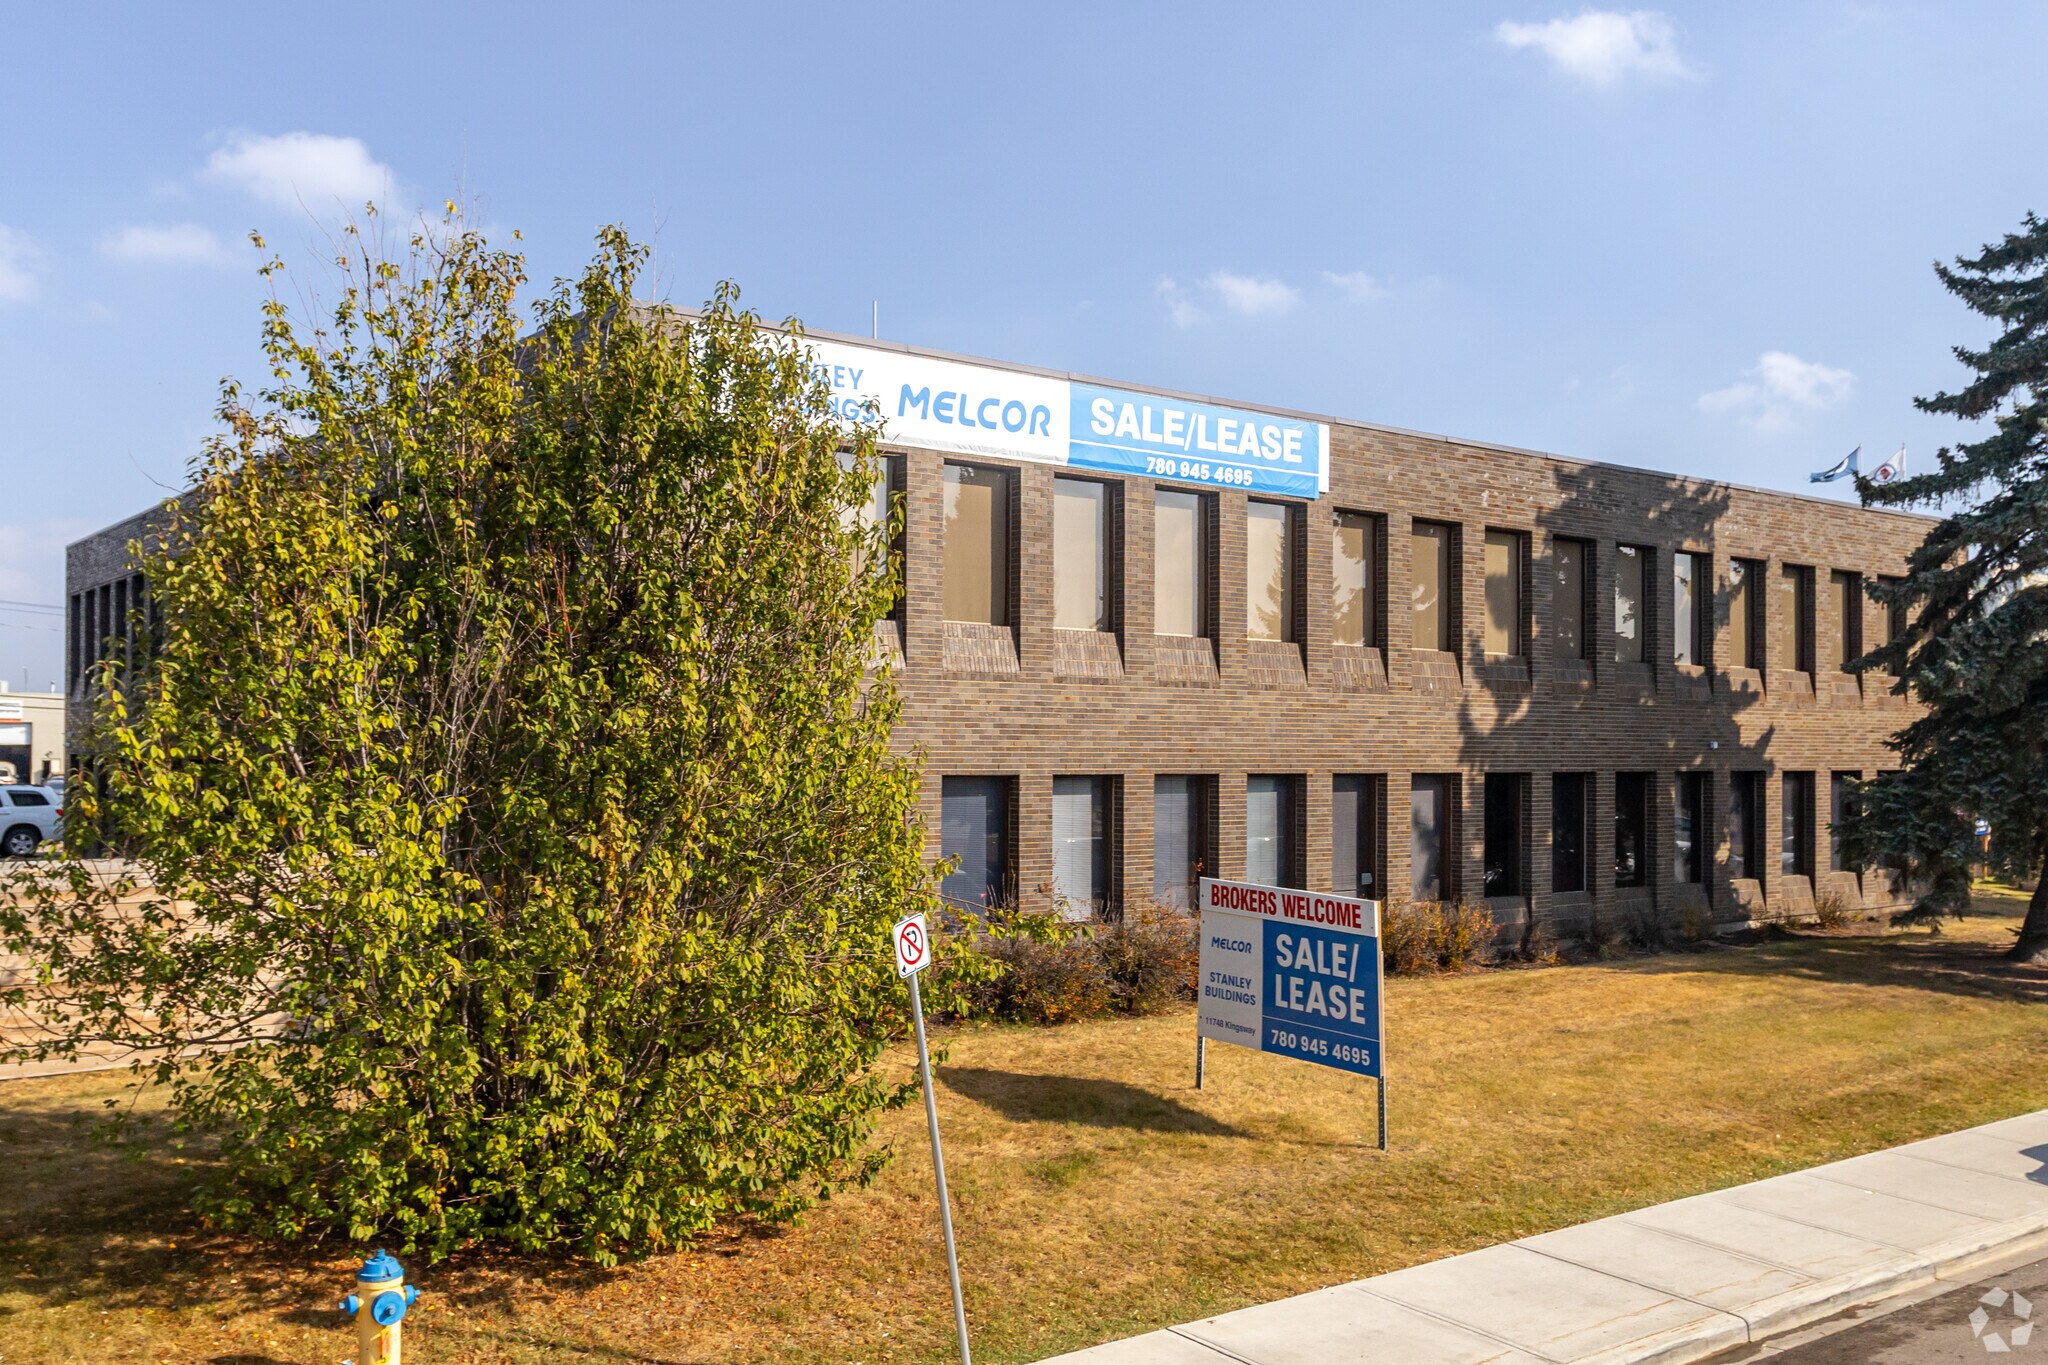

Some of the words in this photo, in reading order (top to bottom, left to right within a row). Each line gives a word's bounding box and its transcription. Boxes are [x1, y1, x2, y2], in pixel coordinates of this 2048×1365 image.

[898, 384, 1051, 437] MELCOR
[1090, 398, 1303, 464] SALE/LEASE
[1146, 457, 1176, 476] 780
[1180, 461, 1210, 480] 945
[1214, 467, 1253, 486] 4695
[1211, 884, 1277, 916] BROKERS
[1282, 894, 1362, 929] WELCOME
[1211, 936, 1252, 954] MELCOR
[1275, 933, 1360, 983] SALE/
[1205, 985, 1256, 1006] BUILDINGS
[1209, 971, 1252, 990] STANLEY
[1275, 973, 1366, 1025] LEASE
[1205, 1017, 1224, 1028] 11748
[1225, 1020, 1256, 1036] Kingsway
[1271, 1029, 1297, 1049] 780
[1300, 1035, 1328, 1056] 945
[1332, 1044, 1370, 1066] 4695
